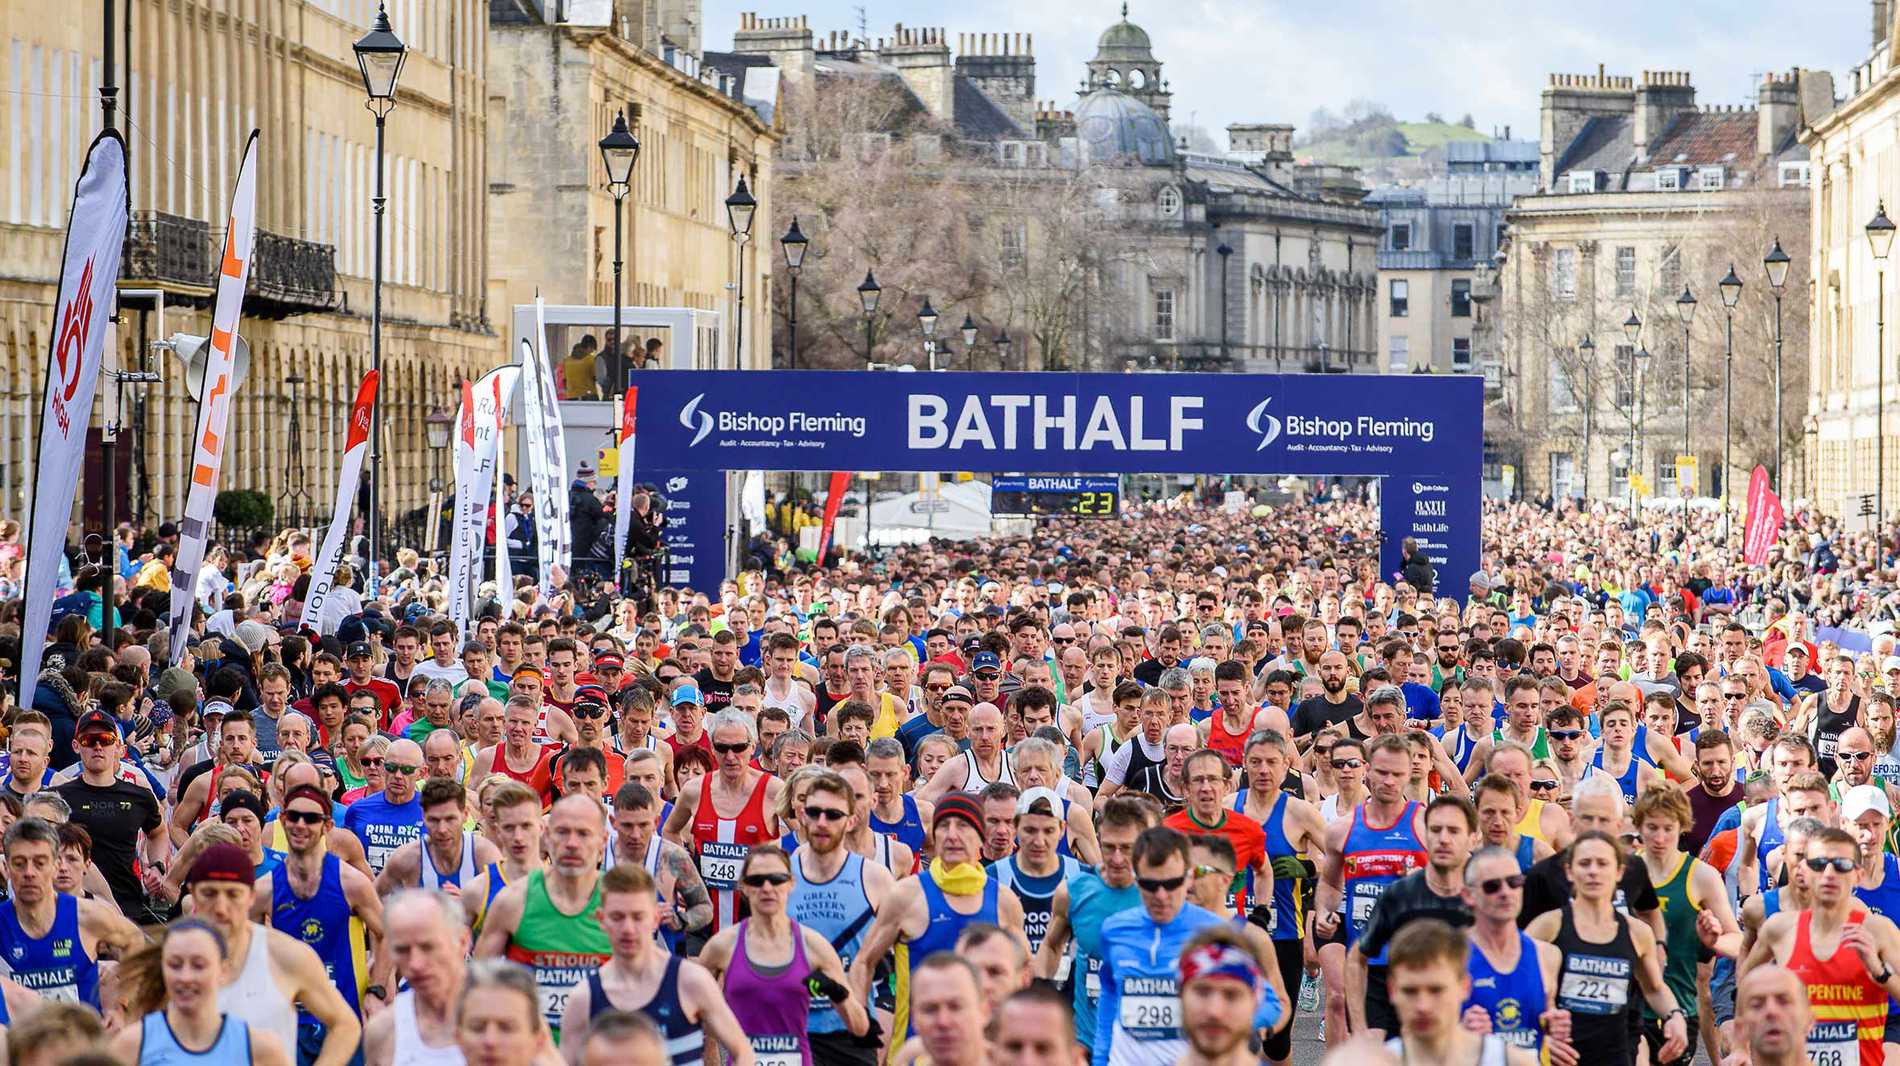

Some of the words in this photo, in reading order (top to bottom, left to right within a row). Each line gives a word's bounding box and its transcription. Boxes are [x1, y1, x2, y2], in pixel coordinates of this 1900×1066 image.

[53, 388, 70, 441] HIGH
[719, 412, 785, 436] Bishop
[789, 412, 866, 437] Fleming
[908, 394, 1204, 451] BATHALF
[1286, 416, 1353, 441] Bishop
[1357, 417, 1434, 442] Fleming
[740, 440, 780, 448] Accountancy
[798, 440, 825, 449] Advisory
[1308, 444, 1347, 453] Accountancy
[1366, 444, 1393, 453] Advisory
[1028, 478, 1082, 489] BATHALF
[1415, 500, 1446, 512] BATH
[1821, 731, 1839, 740] BATH
[703, 843, 749, 857] BATHALF
[710, 862, 736, 880] 248
[803, 891, 838, 901] GREAT
[1355, 883, 1384, 895] BATH
[795, 902, 846, 911] WESTERN
[1568, 956, 1630, 976] BATHALF
[1577, 980, 1610, 999] 224
[1808, 984, 1865, 1000] PENTINE
[1138, 1005, 1172, 1026] 298
[752, 1036, 799, 1050] ATHALF
